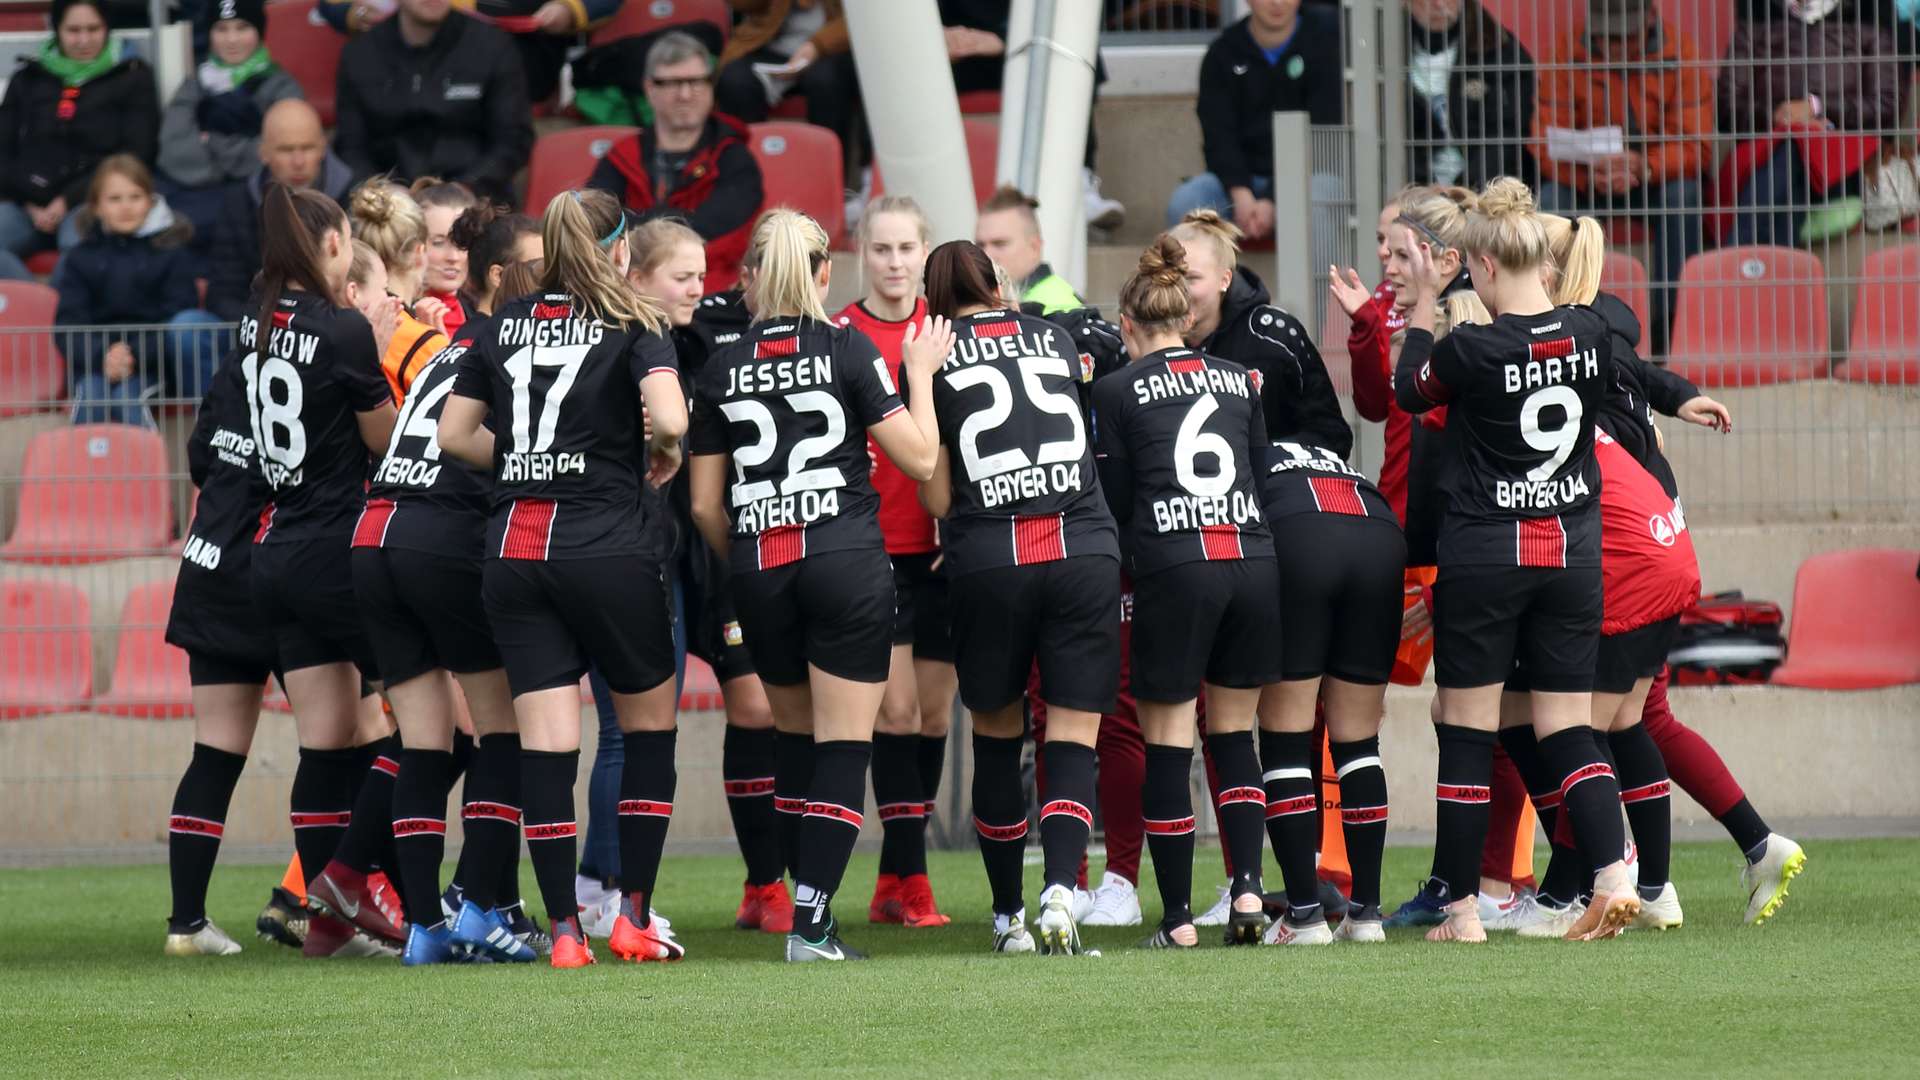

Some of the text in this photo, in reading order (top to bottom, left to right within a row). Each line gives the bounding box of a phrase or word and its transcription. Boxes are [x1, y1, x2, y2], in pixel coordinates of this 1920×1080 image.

[499, 317, 603, 347] RINGSING
[725, 354, 832, 397] JESSEN
[1505, 348, 1599, 393] BARTH
[241, 351, 307, 470] 18
[386, 362, 459, 461] 14
[503, 344, 593, 453] 17
[944, 356, 1086, 482] 25
[1520, 385, 1583, 482] 9
[557, 452, 586, 474] 04
[719, 390, 847, 508] 22
[1174, 392, 1236, 497] 6
[980, 462, 1082, 508] BAYER 04
[1496, 472, 1589, 509] BAYER 04
[801, 489, 840, 522] 04
[1153, 490, 1261, 533] BAYER 04
[1055, 801, 1089, 820] JAKO
[1228, 790, 1261, 800] JAKO
[1290, 798, 1316, 811] JAK
[1454, 787, 1490, 800] JAKO
[395, 820, 429, 833] JAKO
[534, 824, 571, 837] JAKO
[991, 824, 1027, 837] JAKO
